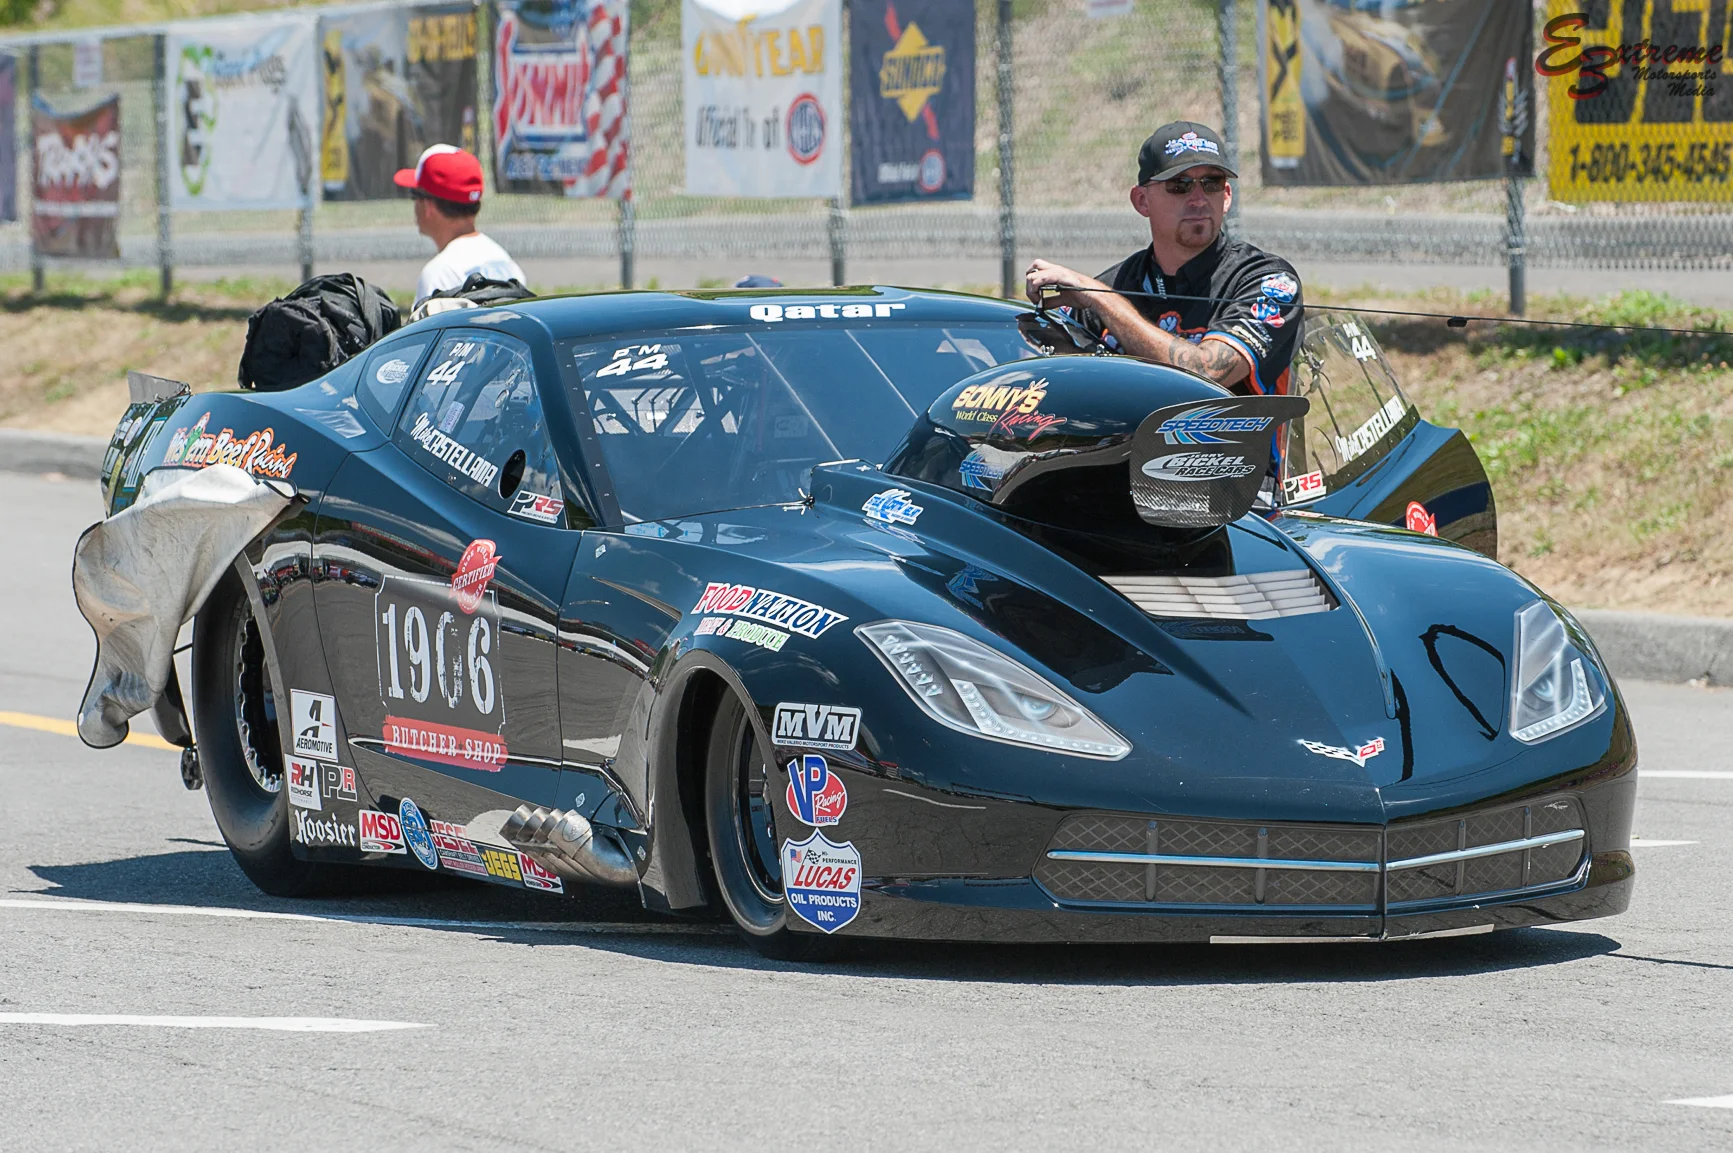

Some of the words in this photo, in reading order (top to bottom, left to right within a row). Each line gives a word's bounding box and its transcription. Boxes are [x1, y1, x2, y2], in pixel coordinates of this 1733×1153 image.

[750, 303, 905, 322] Qatar
[1352, 335, 1377, 361] 44
[427, 361, 465, 385] 44
[597, 354, 669, 378] 44
[952, 384, 1047, 414] SONNY'S
[956, 411, 977, 421] World
[977, 411, 998, 423] Class
[986, 405, 1067, 443] Racing
[1155, 417, 1274, 433] SPEEDTECH
[208, 431, 257, 467] Beef
[244, 430, 295, 478] Racing
[426, 429, 499, 488] CASTELLANA
[1166, 456, 1245, 467] BICKEL
[1175, 467, 1215, 476] RACE
[1213, 465, 1256, 475] CARS
[453, 562, 494, 592] CERTIFIED
[728, 620, 789, 651] PRODUCE
[778, 705, 854, 740] MVM
[296, 736, 333, 754] AEROMOTIVE
[392, 725, 457, 757] BUTCHER
[466, 738, 501, 764] SHOP
[291, 762, 315, 788] RH
[787, 755, 828, 824] VP
[815, 790, 845, 815] Racing
[295, 809, 356, 847] Hoosier
[362, 813, 400, 840] MSD
[481, 849, 522, 881] JEGS
[793, 865, 856, 890] LUCAS
[791, 893, 807, 904] OIL
[808, 895, 857, 908] PRODUCTS
[817, 910, 837, 922] INC.
